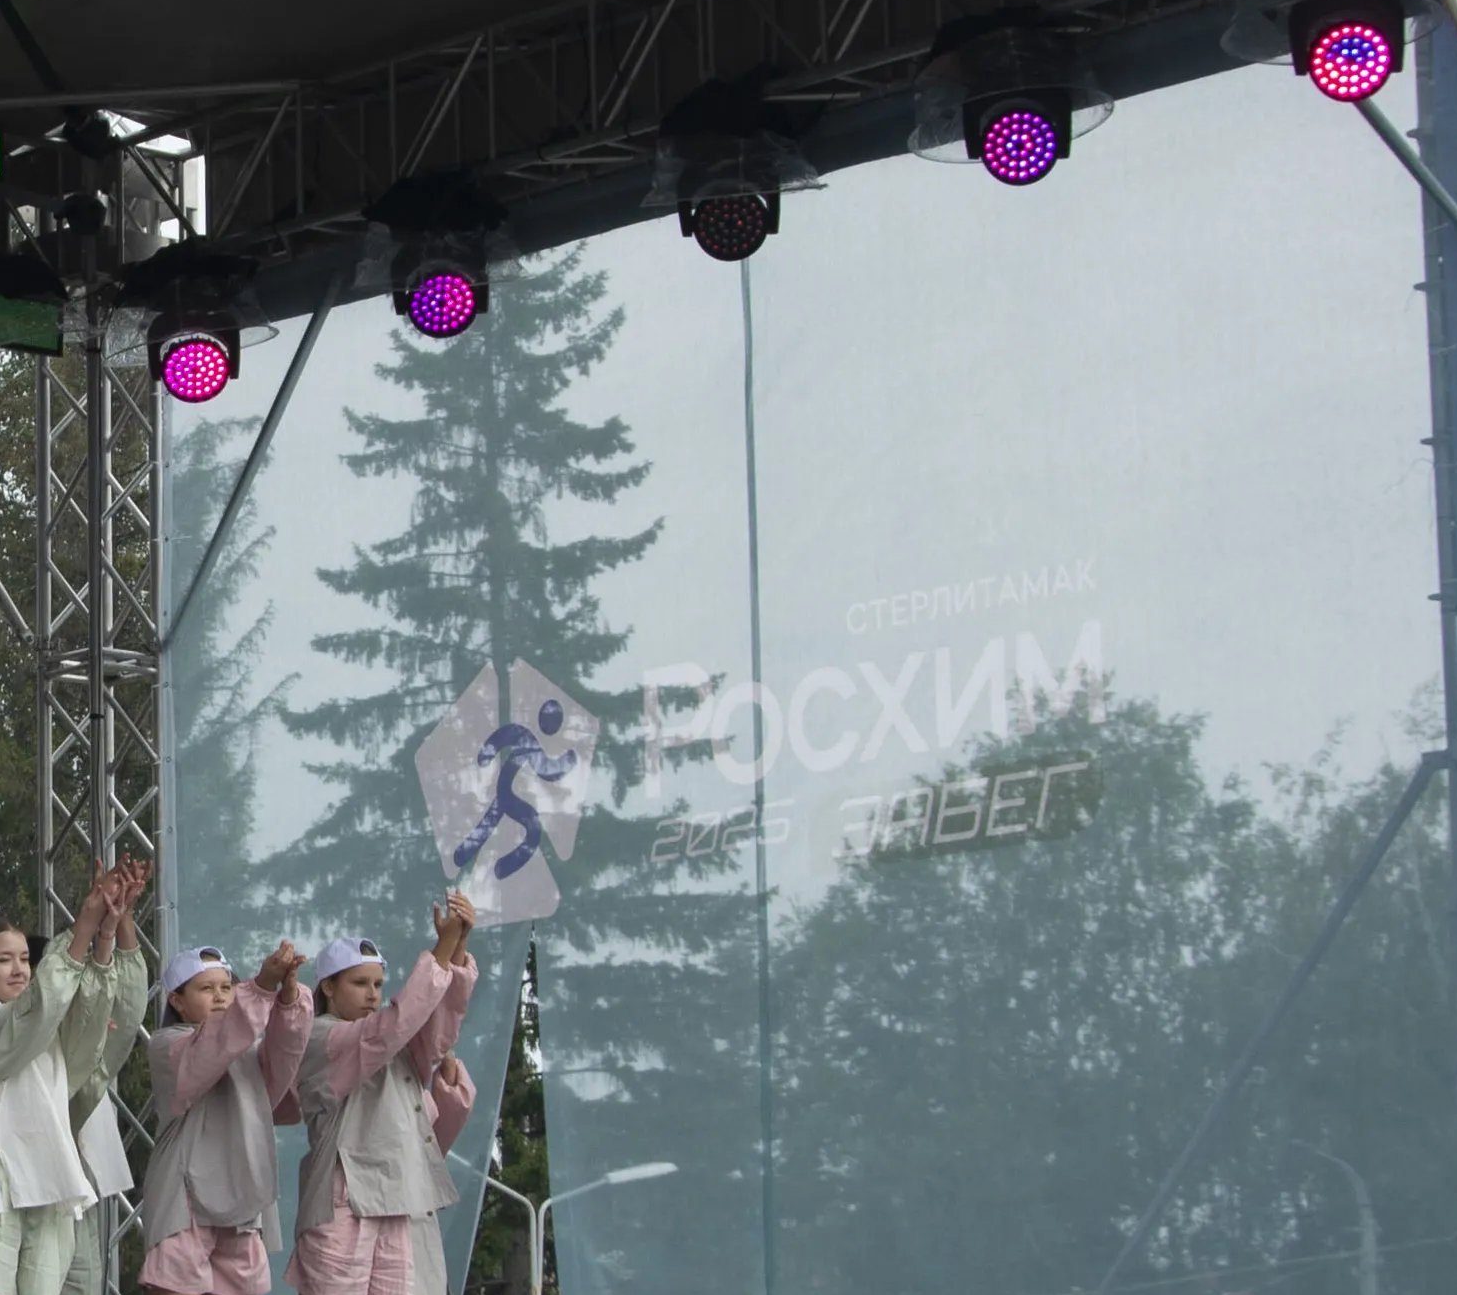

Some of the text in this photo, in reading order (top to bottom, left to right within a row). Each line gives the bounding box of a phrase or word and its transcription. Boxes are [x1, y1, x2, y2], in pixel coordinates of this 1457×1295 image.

[846, 559, 1099, 635] СТЕРЛИТАМАК
[650, 761, 1090, 863] 2025 ЗАБЕГ
